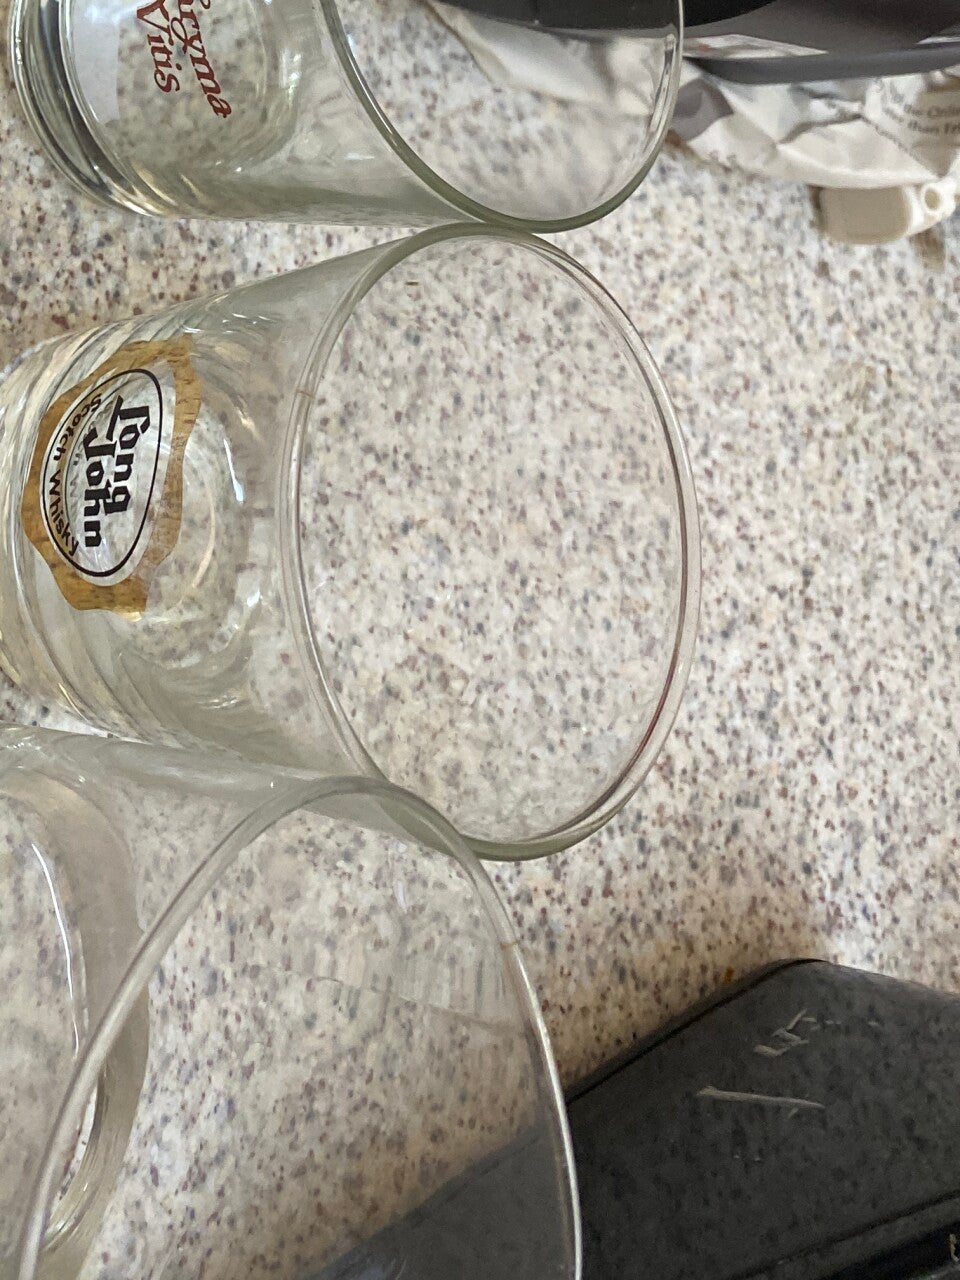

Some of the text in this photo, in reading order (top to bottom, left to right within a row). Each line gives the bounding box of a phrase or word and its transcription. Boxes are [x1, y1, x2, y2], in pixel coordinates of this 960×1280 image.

[54, 393, 103, 462] Scotch
[106, 395, 151, 515] Long
[49, 469, 80, 557] Whisky
[83, 425, 117, 548] John
